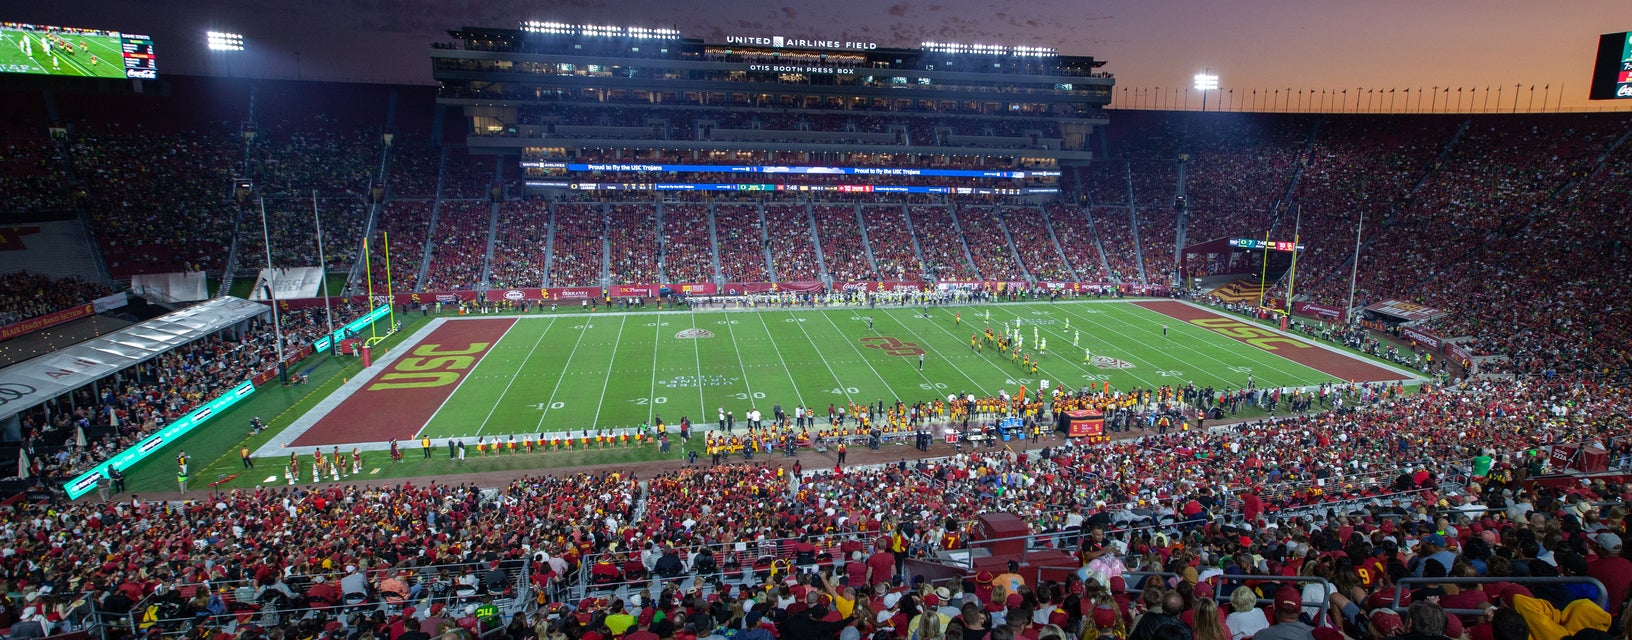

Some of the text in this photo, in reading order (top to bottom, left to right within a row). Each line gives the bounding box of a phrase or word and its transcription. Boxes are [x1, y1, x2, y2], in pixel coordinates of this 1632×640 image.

[726, 36, 877, 50] UNITED AIRLINES FIELD
[2, 310, 83, 337] BLAIR FAMILY BAND SECTION
[1189, 316, 1313, 350] USC
[1404, 328, 1438, 348] POWERADE
[367, 342, 489, 392] USC
[735, 391, 766, 399] 30
[830, 387, 860, 395] 40
[536, 401, 565, 410] 10
[636, 396, 668, 405] 20
[947, 537, 955, 549] 7
[1358, 568, 1371, 584] 9
[477, 607, 493, 618] 24
